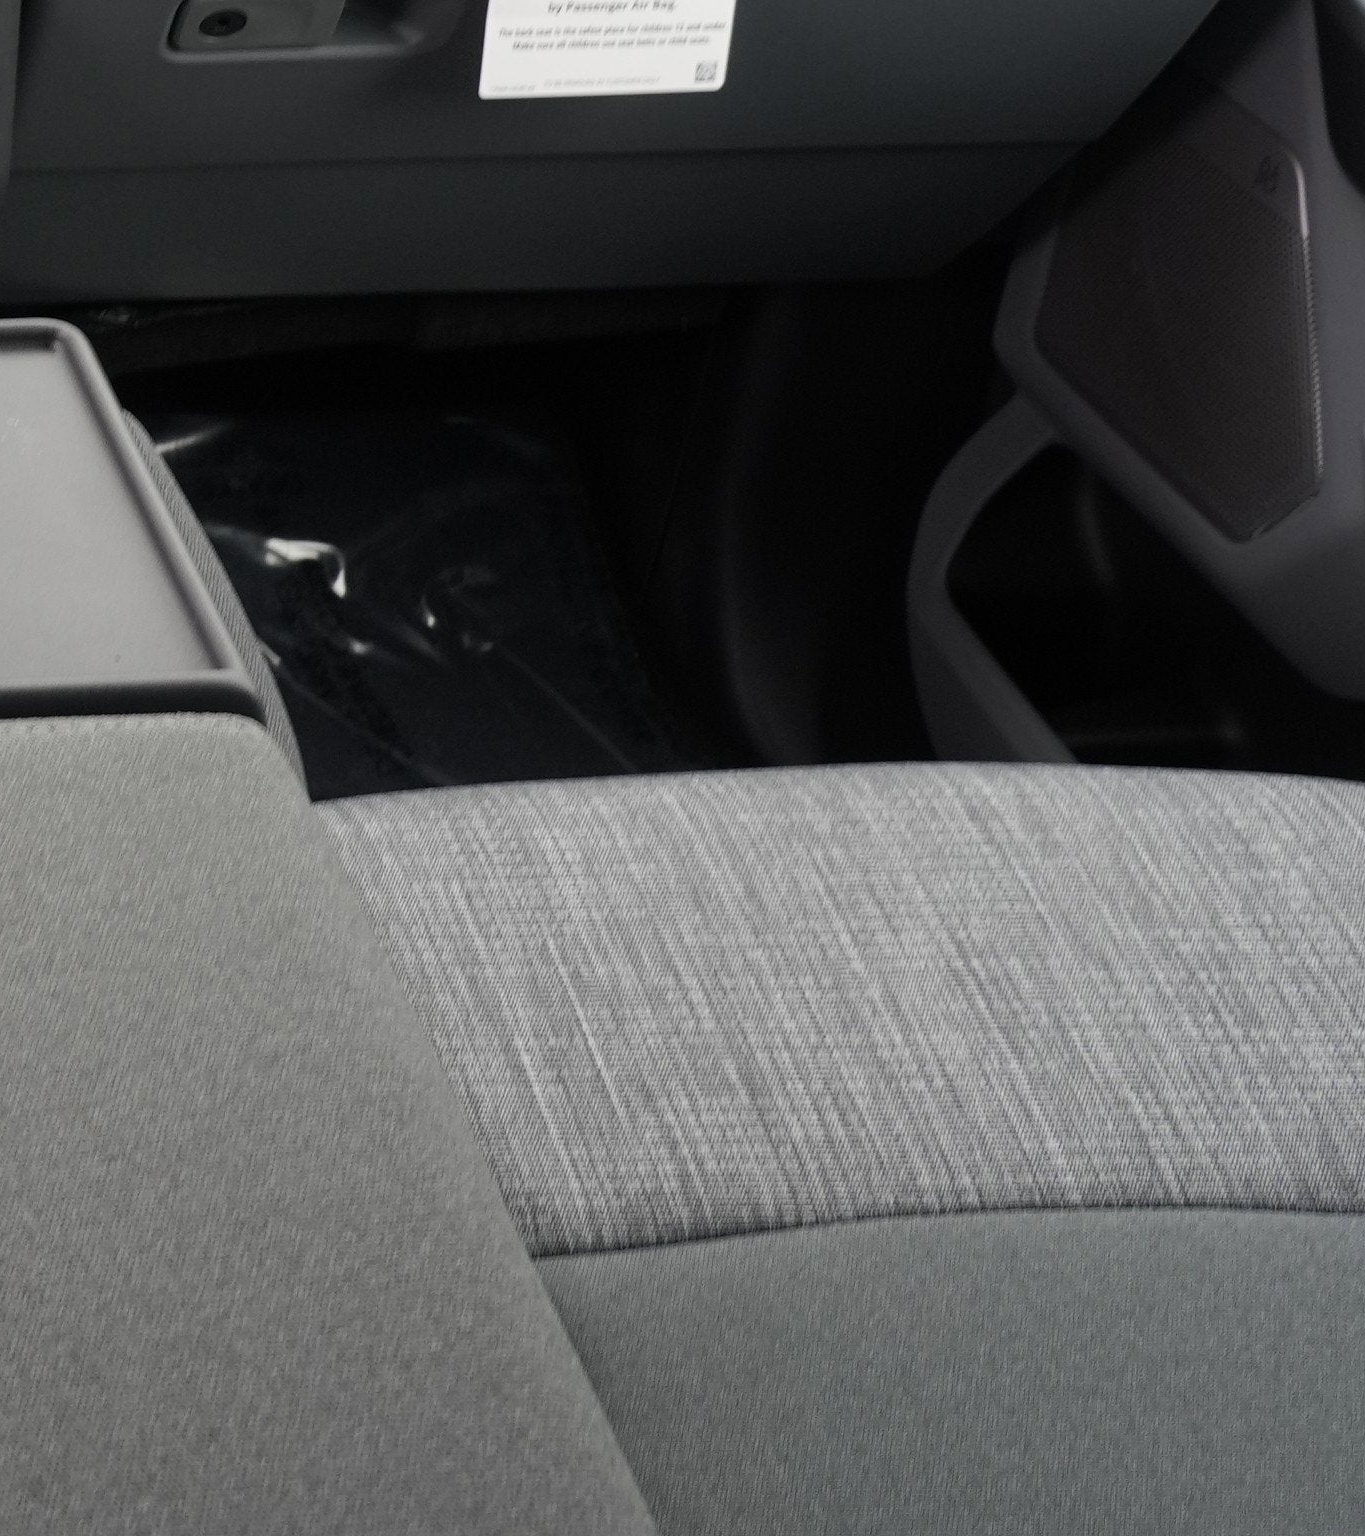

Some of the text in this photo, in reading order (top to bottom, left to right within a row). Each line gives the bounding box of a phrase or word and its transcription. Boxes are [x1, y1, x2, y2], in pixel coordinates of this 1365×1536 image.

[547, 1, 563, 16] by
[565, 0, 628, 14] Passenger
[631, 0, 649, 11] Air
